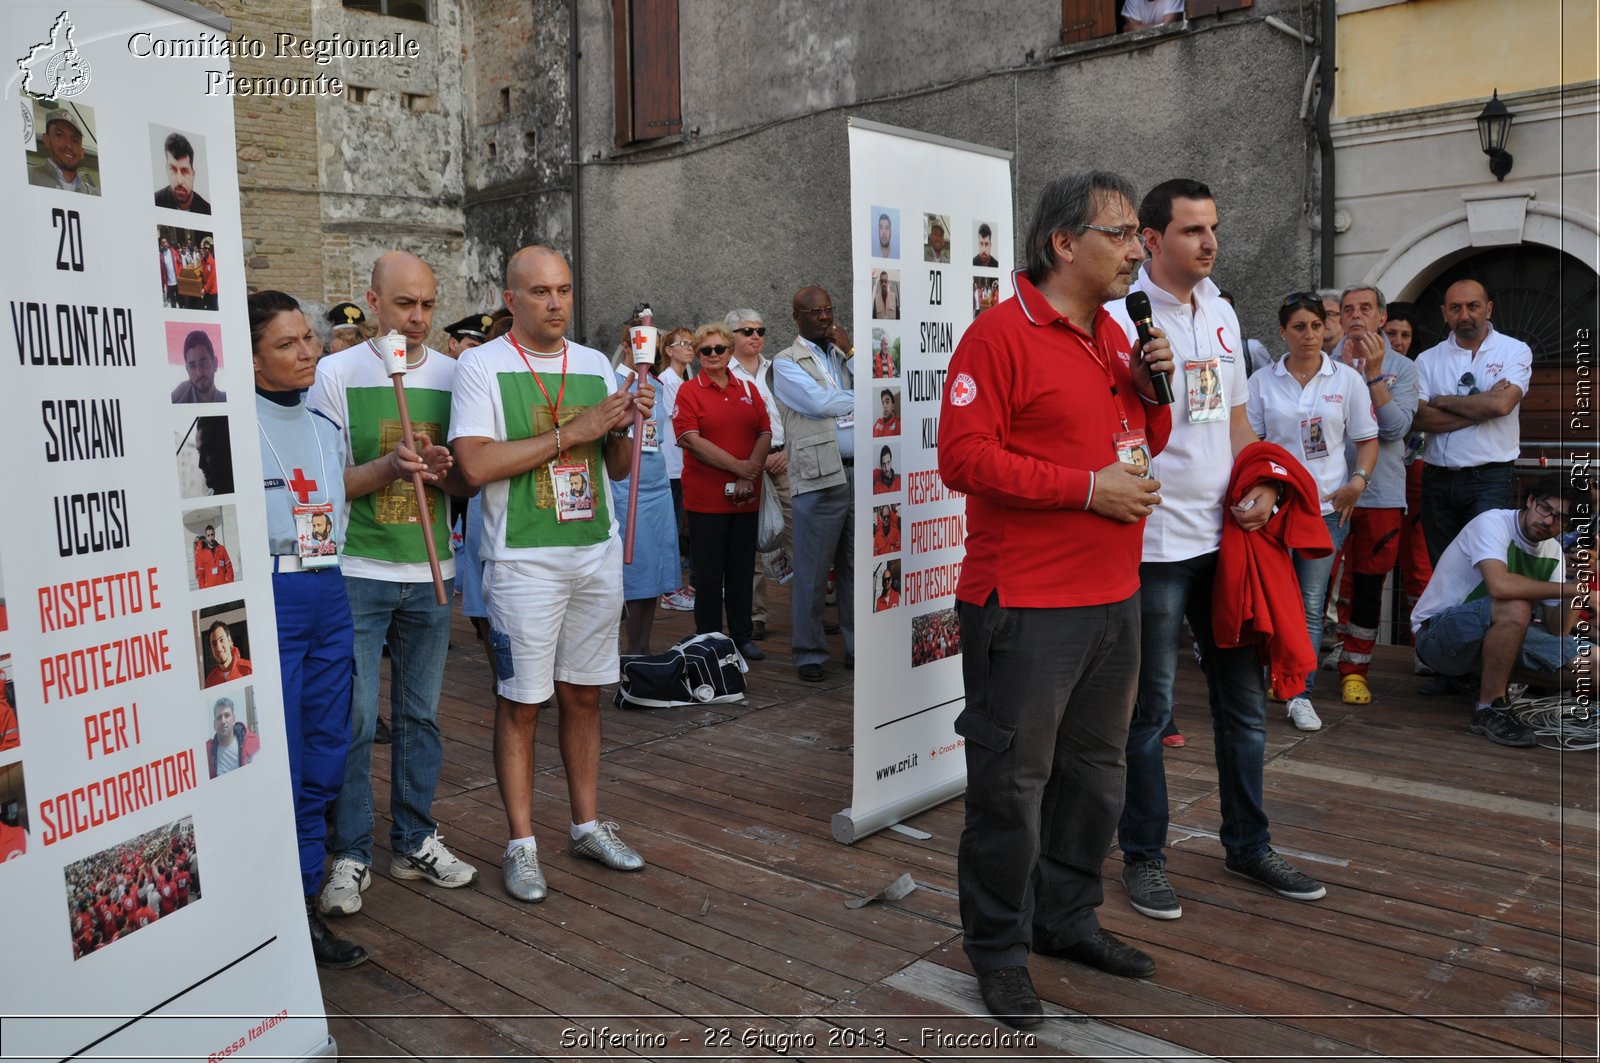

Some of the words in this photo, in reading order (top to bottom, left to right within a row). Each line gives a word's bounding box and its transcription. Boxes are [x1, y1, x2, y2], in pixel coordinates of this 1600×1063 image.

[52, 208, 85, 272] 20
[929, 270, 942, 306] 20
[10, 300, 136, 367] VOLONTARI
[920, 322, 953, 353] SYRIAN
[42, 399, 125, 463] SIRIANI
[54, 489, 130, 558] UCCISI
[911, 515, 964, 554] PROTECTION
[38, 571, 142, 634] RISPETTO
[147, 567, 162, 610] E
[904, 571, 922, 606] FOR
[39, 629, 172, 704] PROTEZIONE
[84, 706, 129, 761] PER
[132, 703, 141, 745] I
[938, 743, 956, 756] Croce
[876, 753, 918, 781] www.cri.it
[39, 748, 198, 847] SOCCORRITORI
[248, 1009, 288, 1041] Italiana
